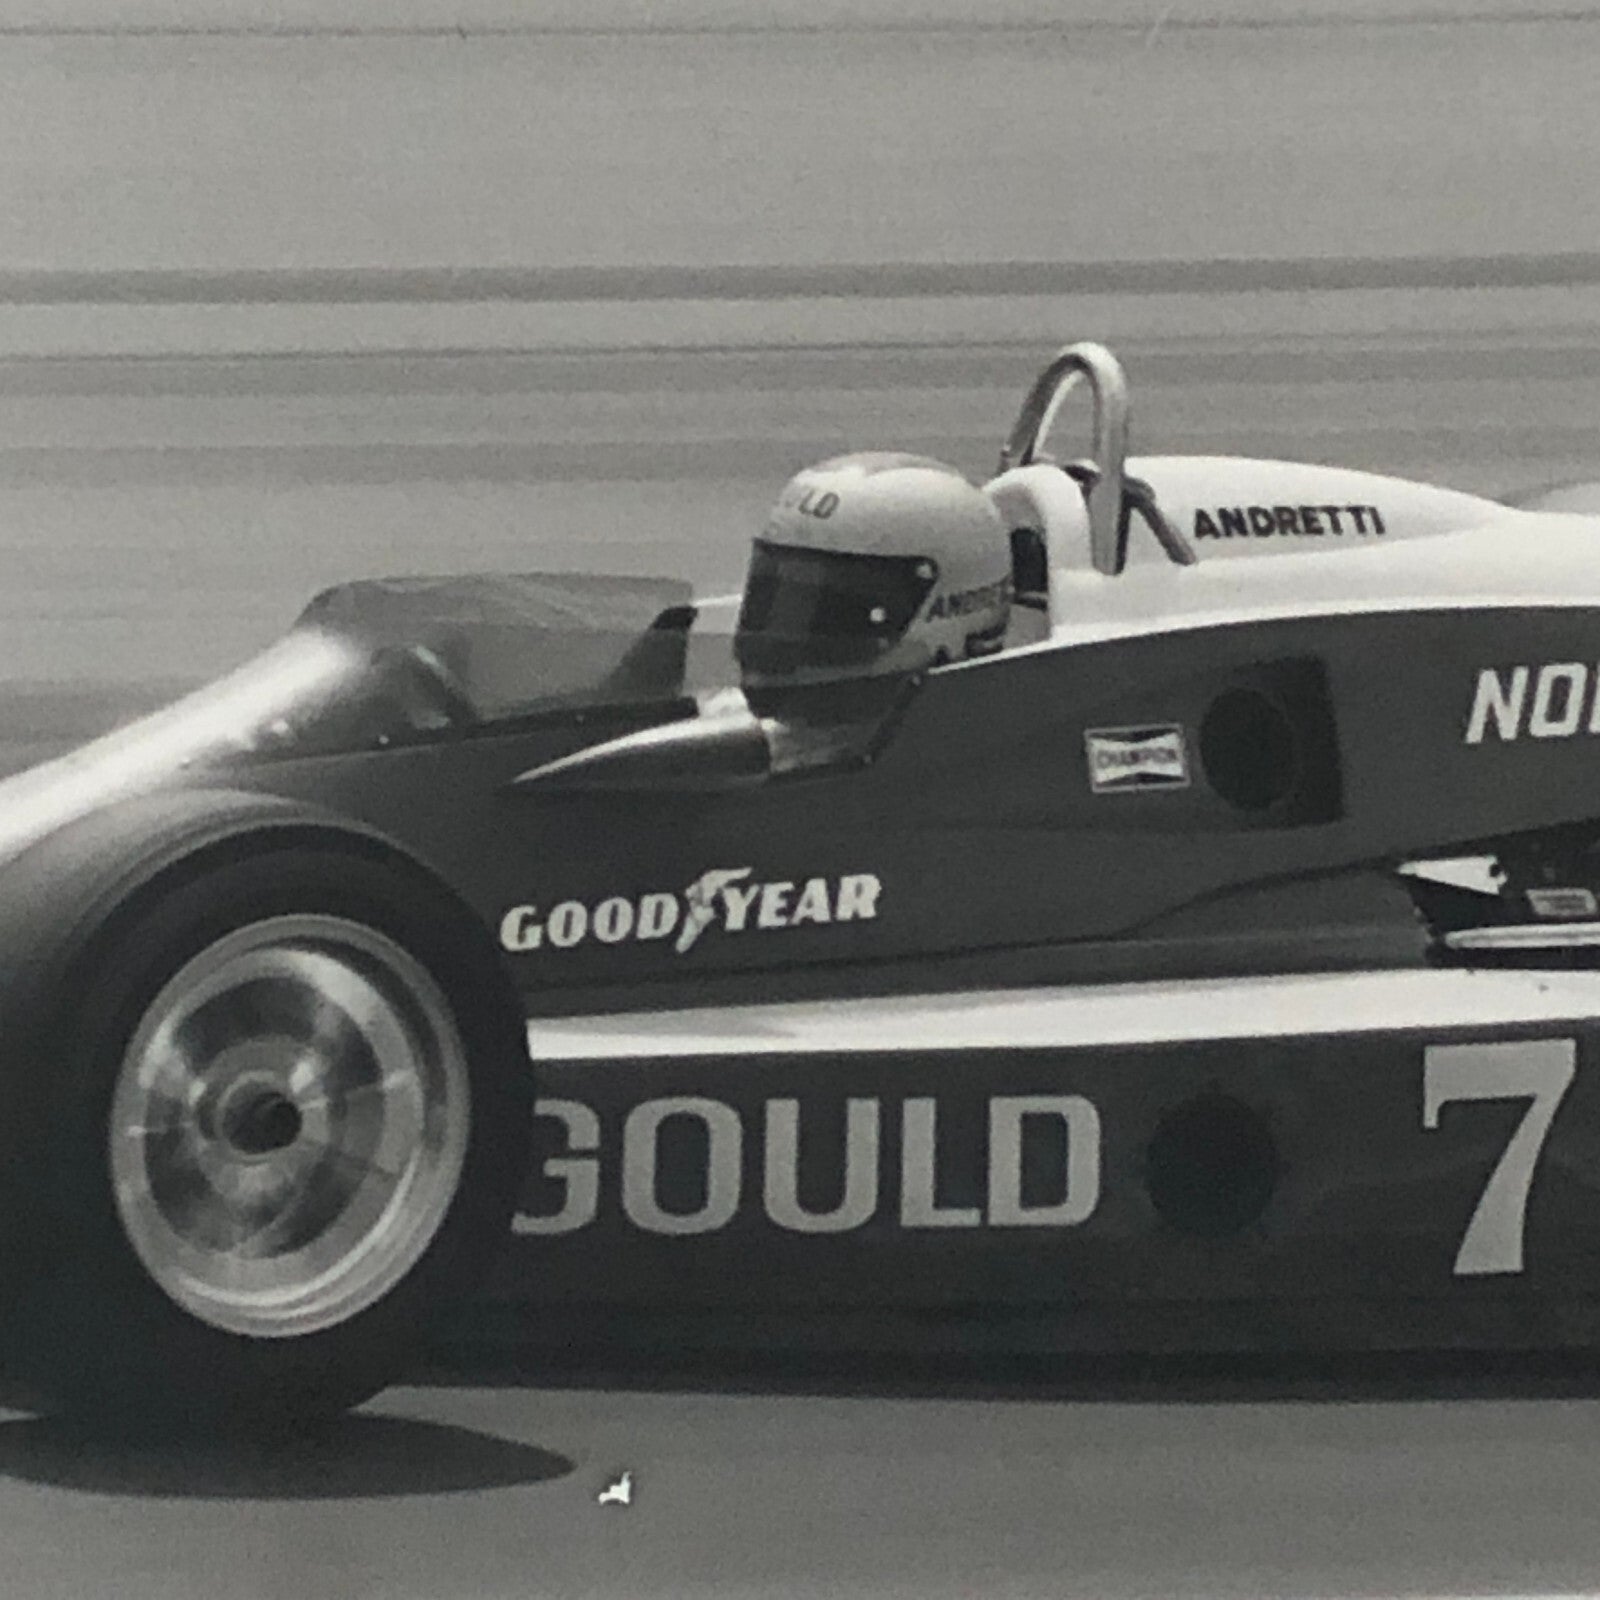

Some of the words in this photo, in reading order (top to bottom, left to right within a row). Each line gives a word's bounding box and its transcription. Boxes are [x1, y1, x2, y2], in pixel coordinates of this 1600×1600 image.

[1194, 505, 1386, 538] ANDRETTI
[1465, 662, 1600, 743] NO
[511, 1096, 1101, 1236] GOULD
[1423, 1038, 1577, 1275] 7
